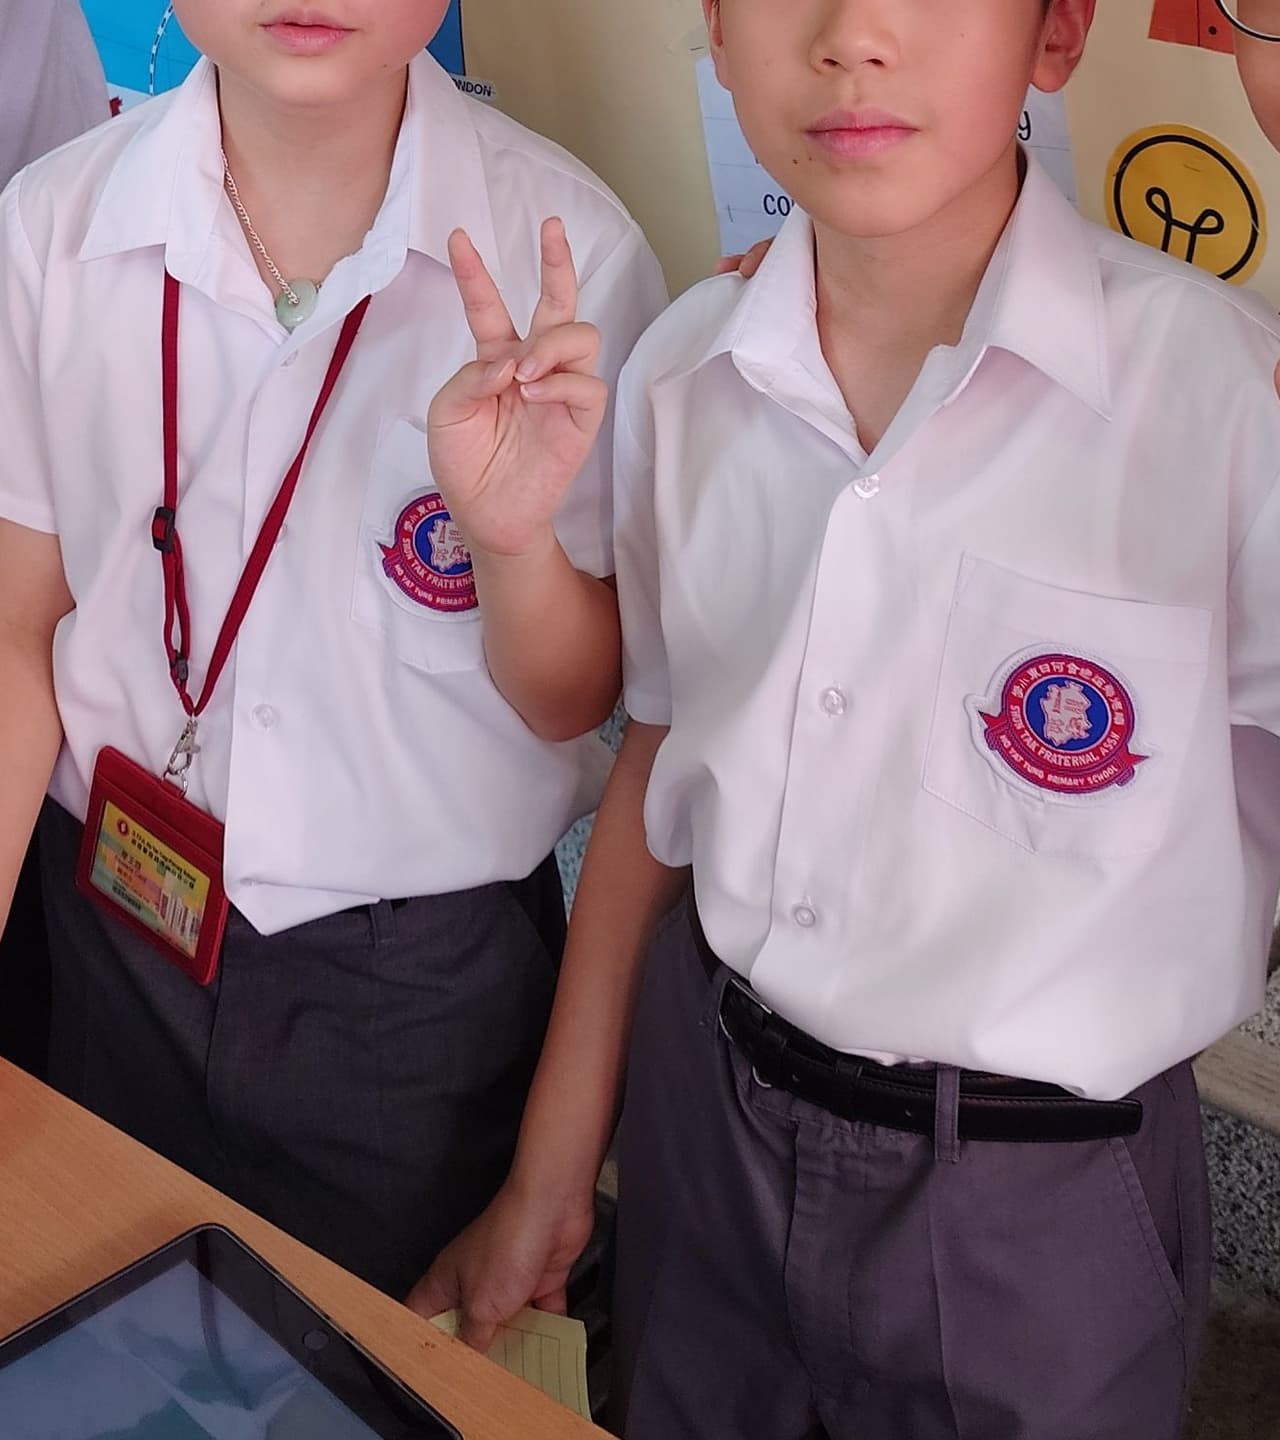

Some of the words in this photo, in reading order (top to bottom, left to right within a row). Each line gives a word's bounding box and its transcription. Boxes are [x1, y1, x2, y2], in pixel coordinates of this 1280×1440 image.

[427, 574, 475, 589] FRATERN
[1010, 704, 1025, 730] SHUN
[1021, 730, 1040, 753] TAK
[1037, 750, 1100, 768] FRATERNAL
[1101, 731, 1121, 756] ASSN
[1086, 765, 1119, 785] SCHOOL
